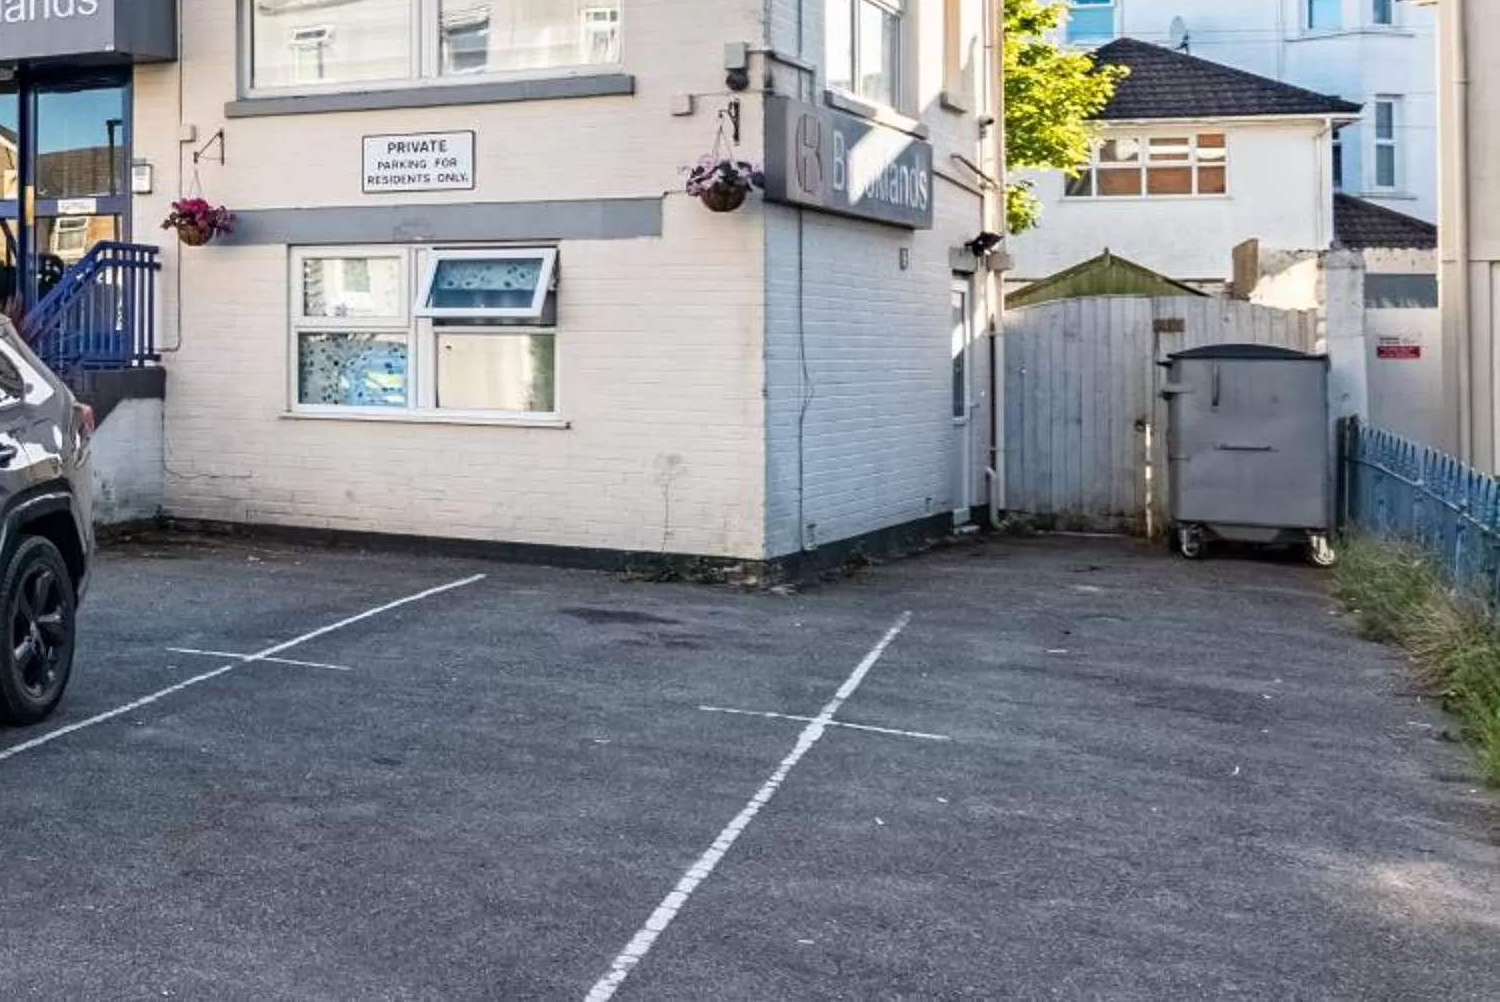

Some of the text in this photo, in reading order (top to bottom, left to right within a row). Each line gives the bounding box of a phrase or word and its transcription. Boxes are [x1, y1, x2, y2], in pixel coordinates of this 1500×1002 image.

[387, 139, 447, 154] PRIVATE
[377, 157, 458, 171] PARKING FOR
[833, 131, 928, 211] Blands
[367, 173, 431, 186] RESIDENTS
